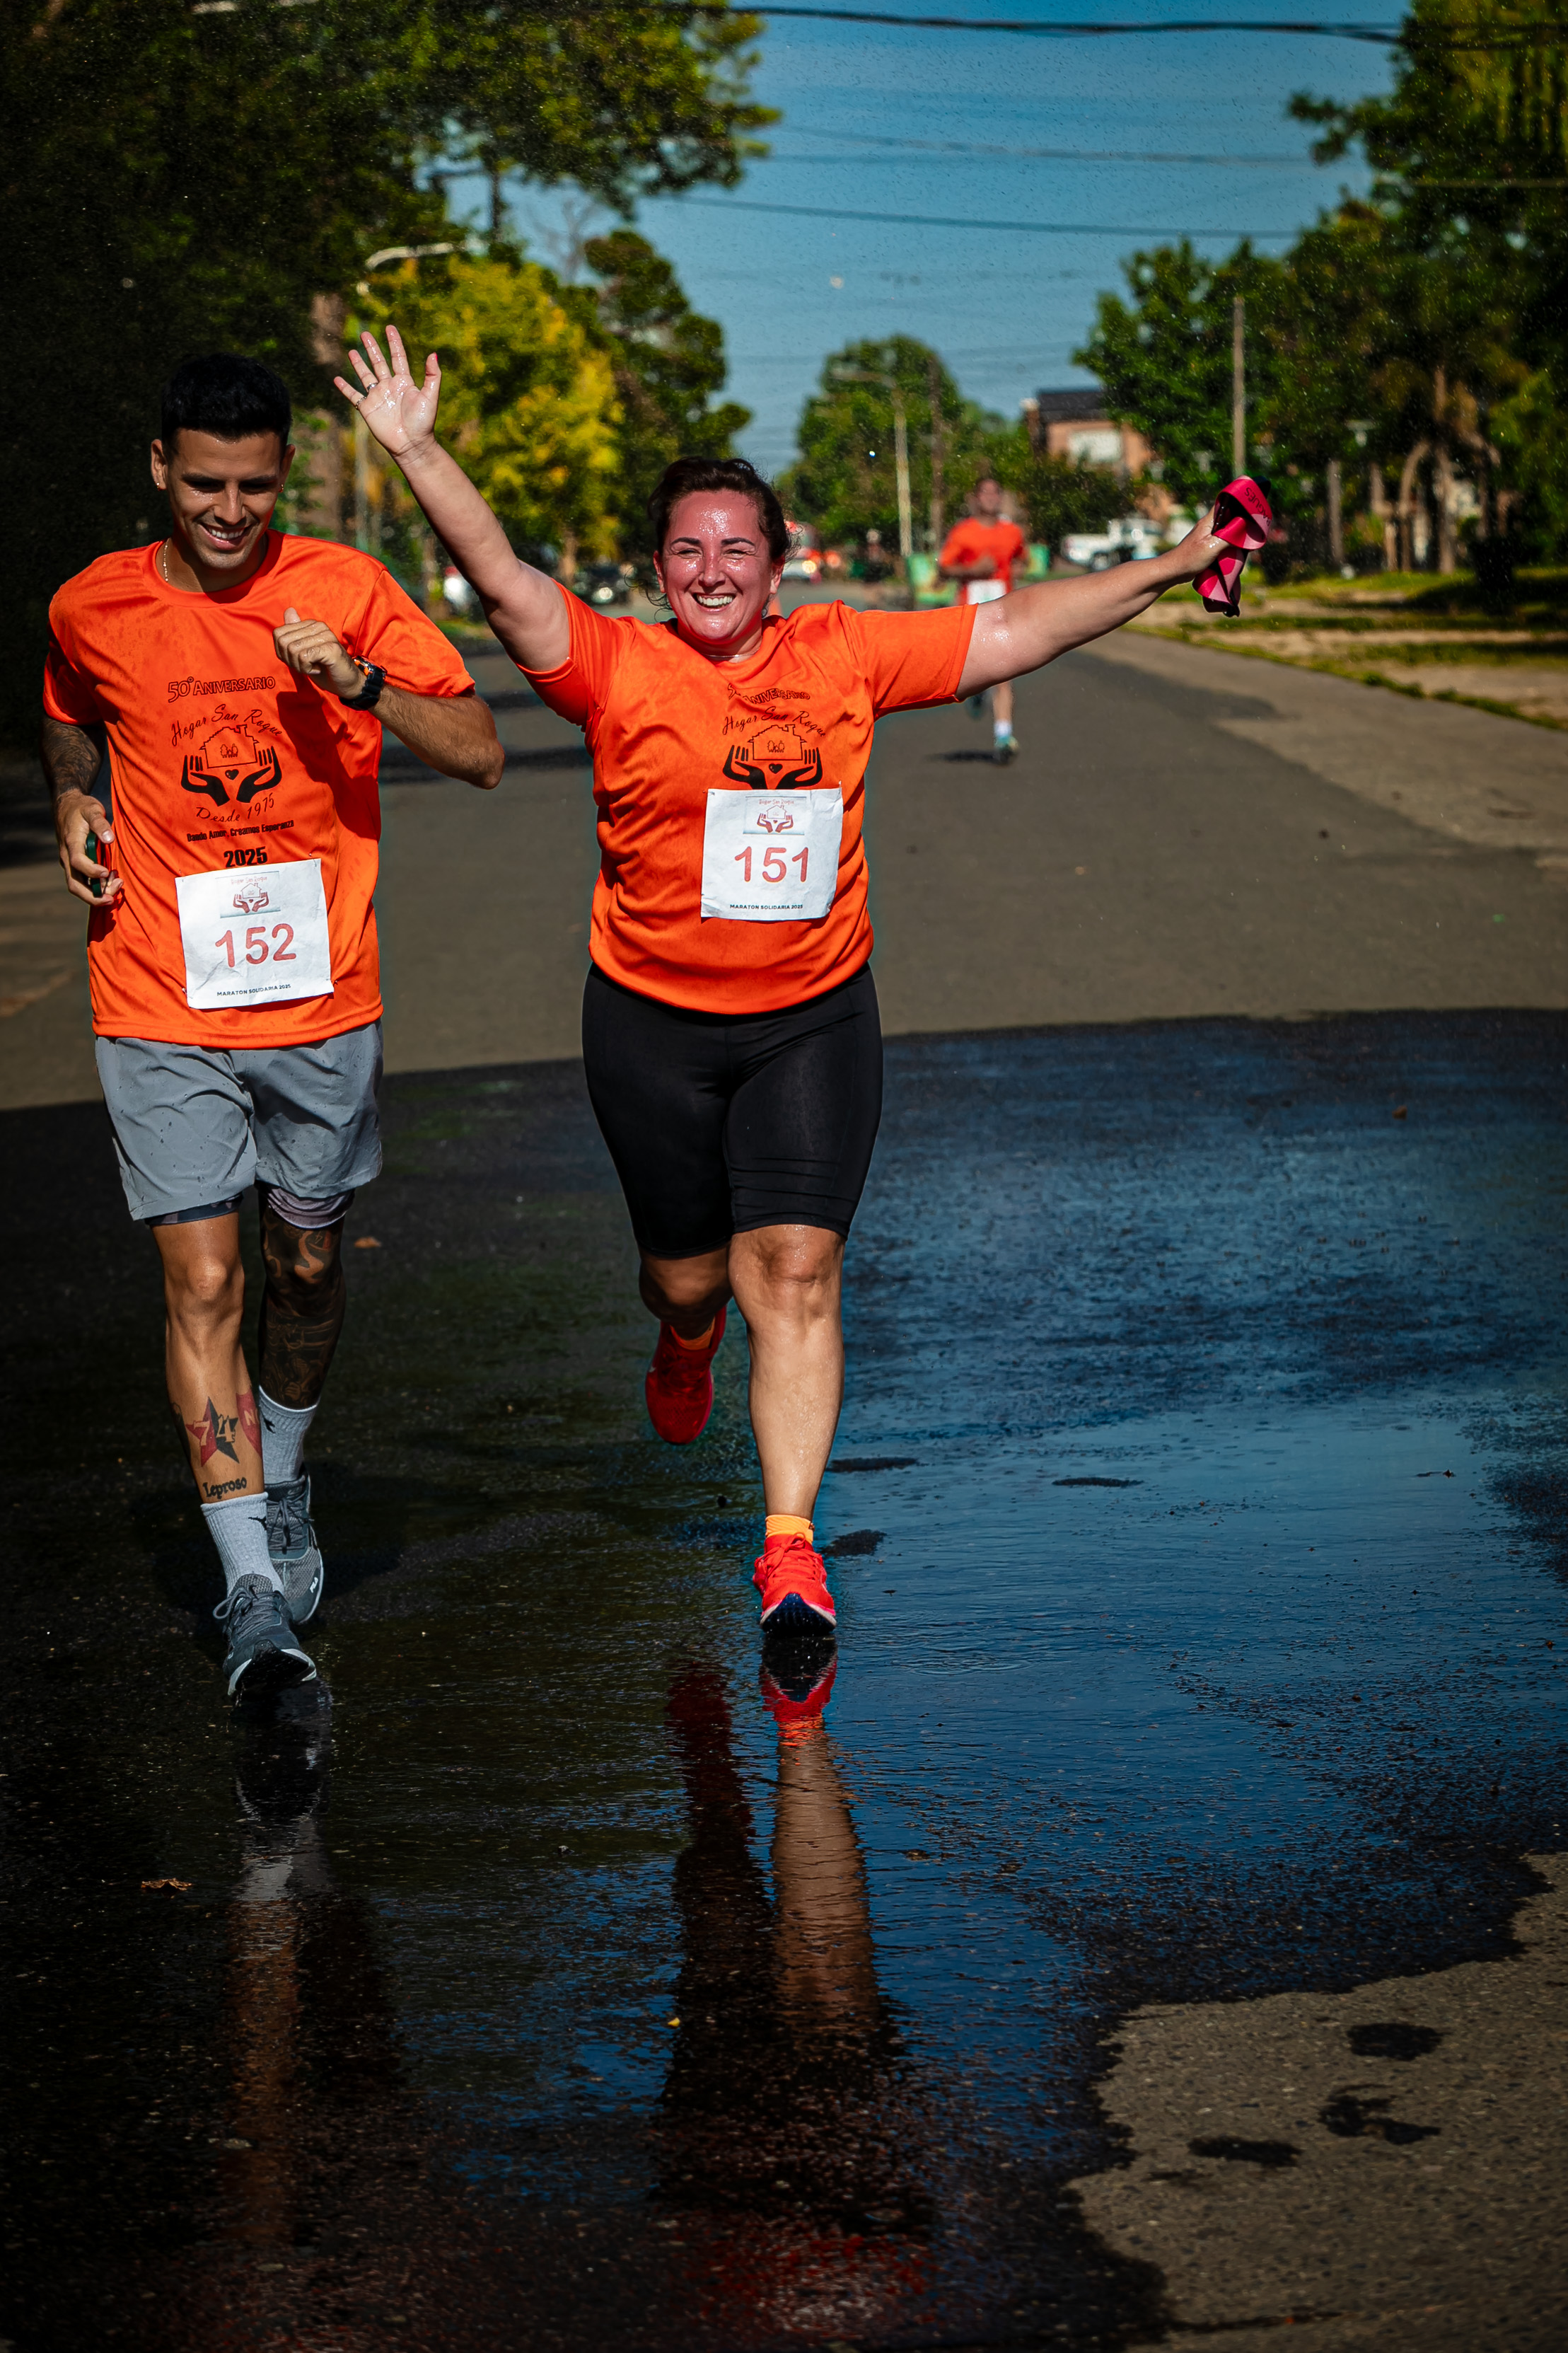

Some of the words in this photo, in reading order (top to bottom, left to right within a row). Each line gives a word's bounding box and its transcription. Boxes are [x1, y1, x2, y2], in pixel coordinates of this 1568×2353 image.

[193, 676, 275, 695] ANIVERSARIO
[171, 717, 207, 747] Hogar
[211, 704, 238, 722] San
[244, 709, 283, 736] Roque
[722, 715, 757, 736] Hogar
[761, 705, 789, 722] San
[793, 710, 826, 737] Roque
[196, 807, 240, 823] Desde
[247, 792, 274, 819] 1975
[187, 832, 207, 842] Dando
[230, 826, 260, 837] Creamos
[261, 820, 294, 833] Esperanza
[223, 846, 267, 868] 2025
[734, 845, 809, 883] 151
[215, 923, 296, 968] 152
[202, 1476, 247, 1500] Leproso
